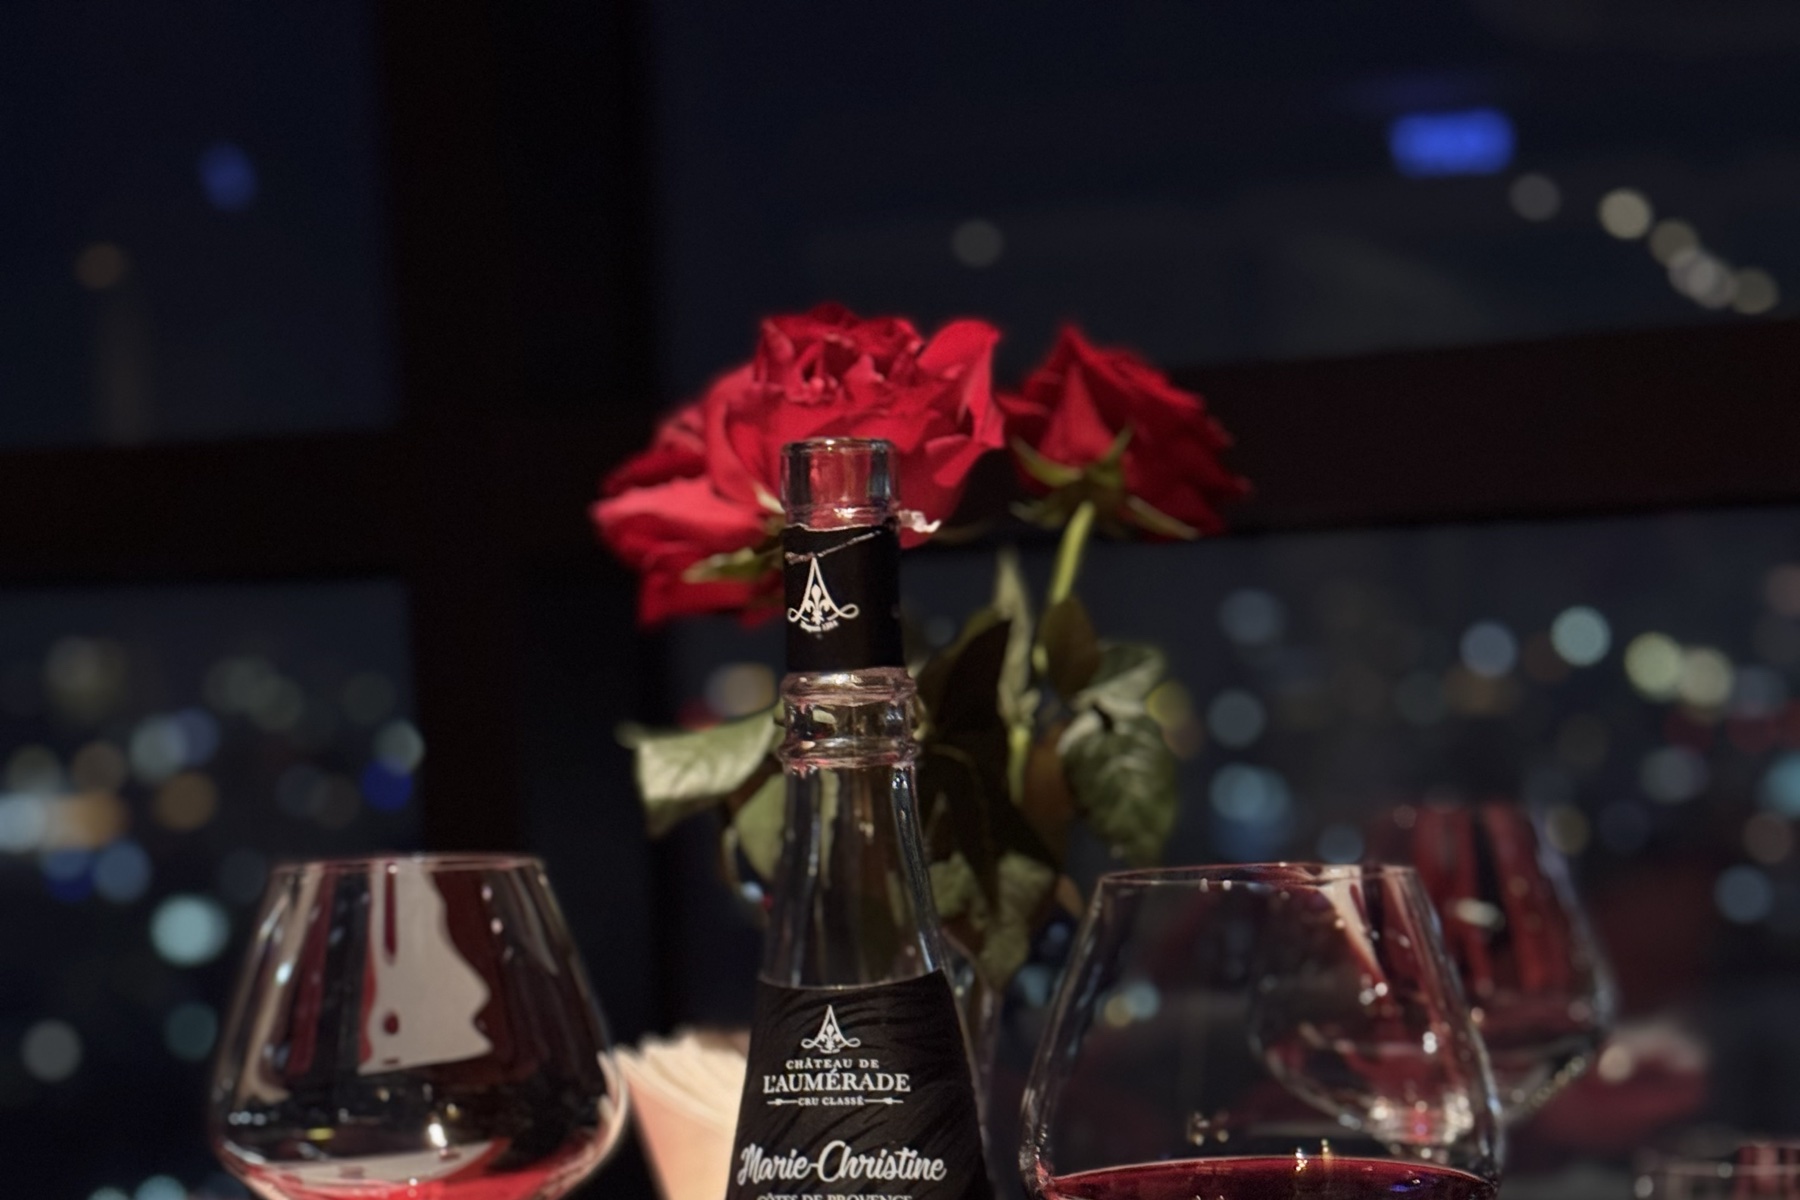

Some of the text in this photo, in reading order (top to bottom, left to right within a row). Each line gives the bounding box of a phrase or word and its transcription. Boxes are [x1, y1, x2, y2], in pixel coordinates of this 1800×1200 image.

[785, 1056, 880, 1070] CHÂTEAU DE
[762, 1067, 912, 1094] L'AUMÉRADE
[798, 1096, 819, 1106] CRU
[736, 1140, 947, 1186] Marie-Christine
